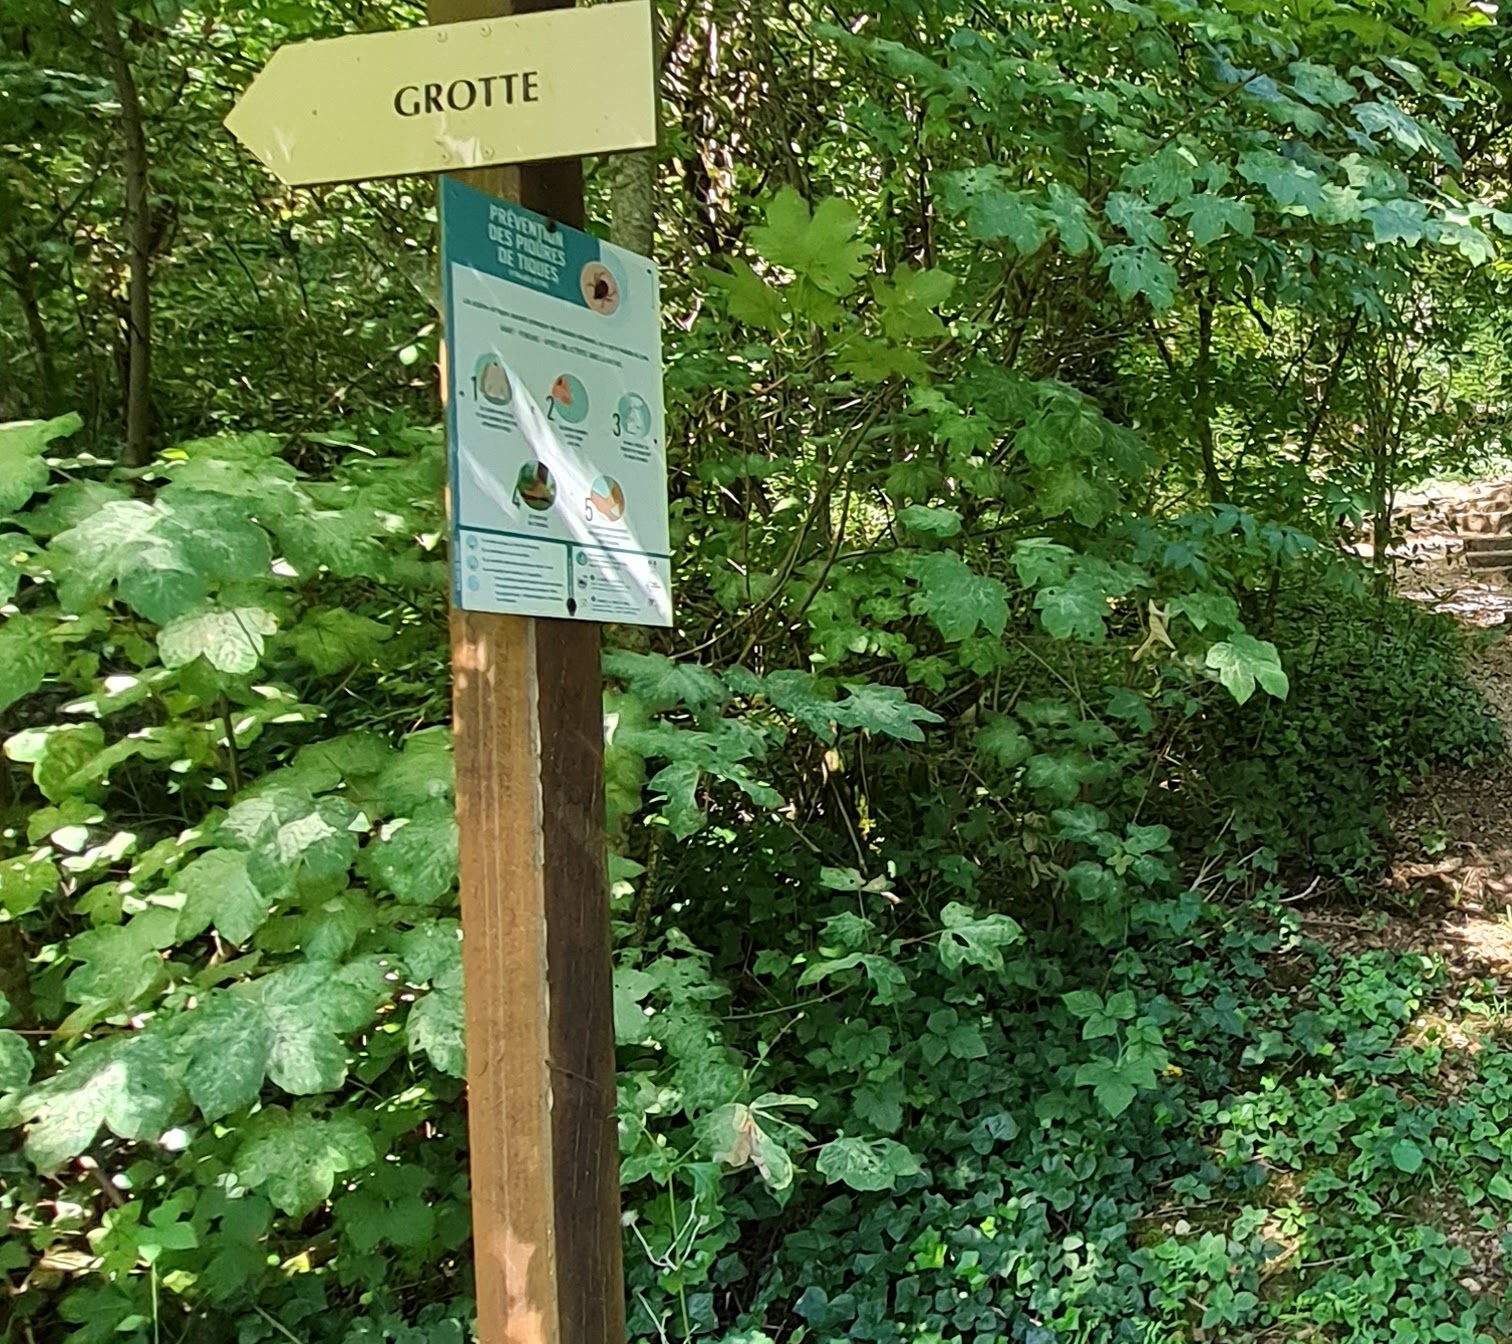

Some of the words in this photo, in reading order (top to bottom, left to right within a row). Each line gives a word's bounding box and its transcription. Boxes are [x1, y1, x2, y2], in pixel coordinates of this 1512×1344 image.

[394, 71, 538, 116] GROTTE
[488, 223, 513, 247] DES
[498, 246, 515, 267] DE
[517, 253, 560, 283] TIQUES
[471, 376, 478, 401] 1
[545, 395, 555, 421] 2
[612, 413, 621, 437] 3
[585, 497, 593, 522] 5
